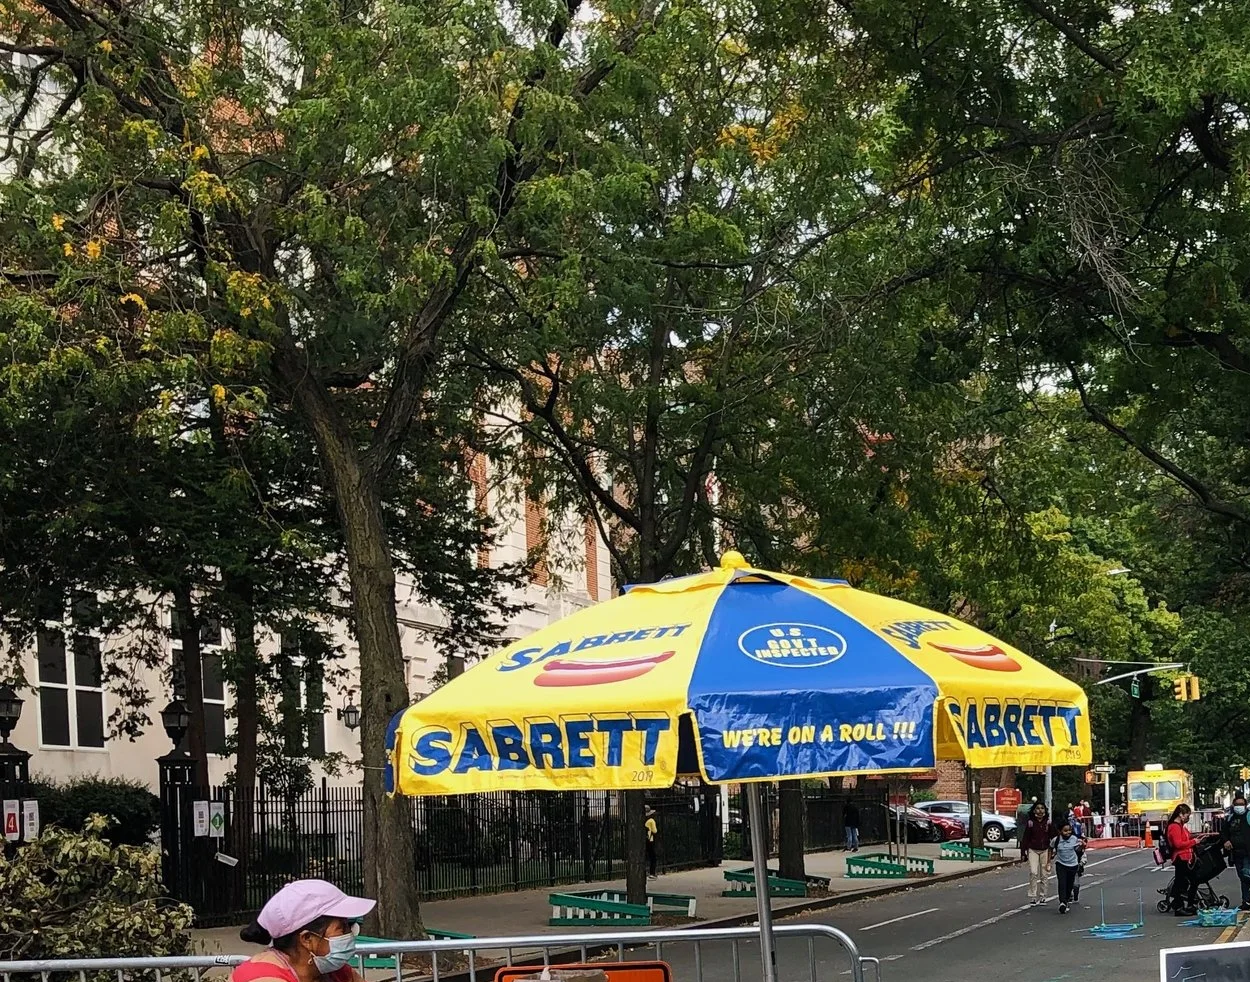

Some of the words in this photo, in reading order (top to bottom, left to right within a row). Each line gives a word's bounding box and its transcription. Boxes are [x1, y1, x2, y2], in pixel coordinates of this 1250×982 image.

[769, 627, 805, 638] U.S.
[495, 621, 692, 673] SABRETT
[754, 645, 840, 659] INSPECTED
[766, 637, 819, 651] GOV'T
[722, 726, 782, 748] WE'RE
[787, 725, 816, 746] ON
[820, 724, 834, 743] A
[839, 722, 887, 743] ROLL
[892, 721, 917, 740] !!!
[407, 710, 671, 777] SABRETT
[8, 815, 15, 831] 4
